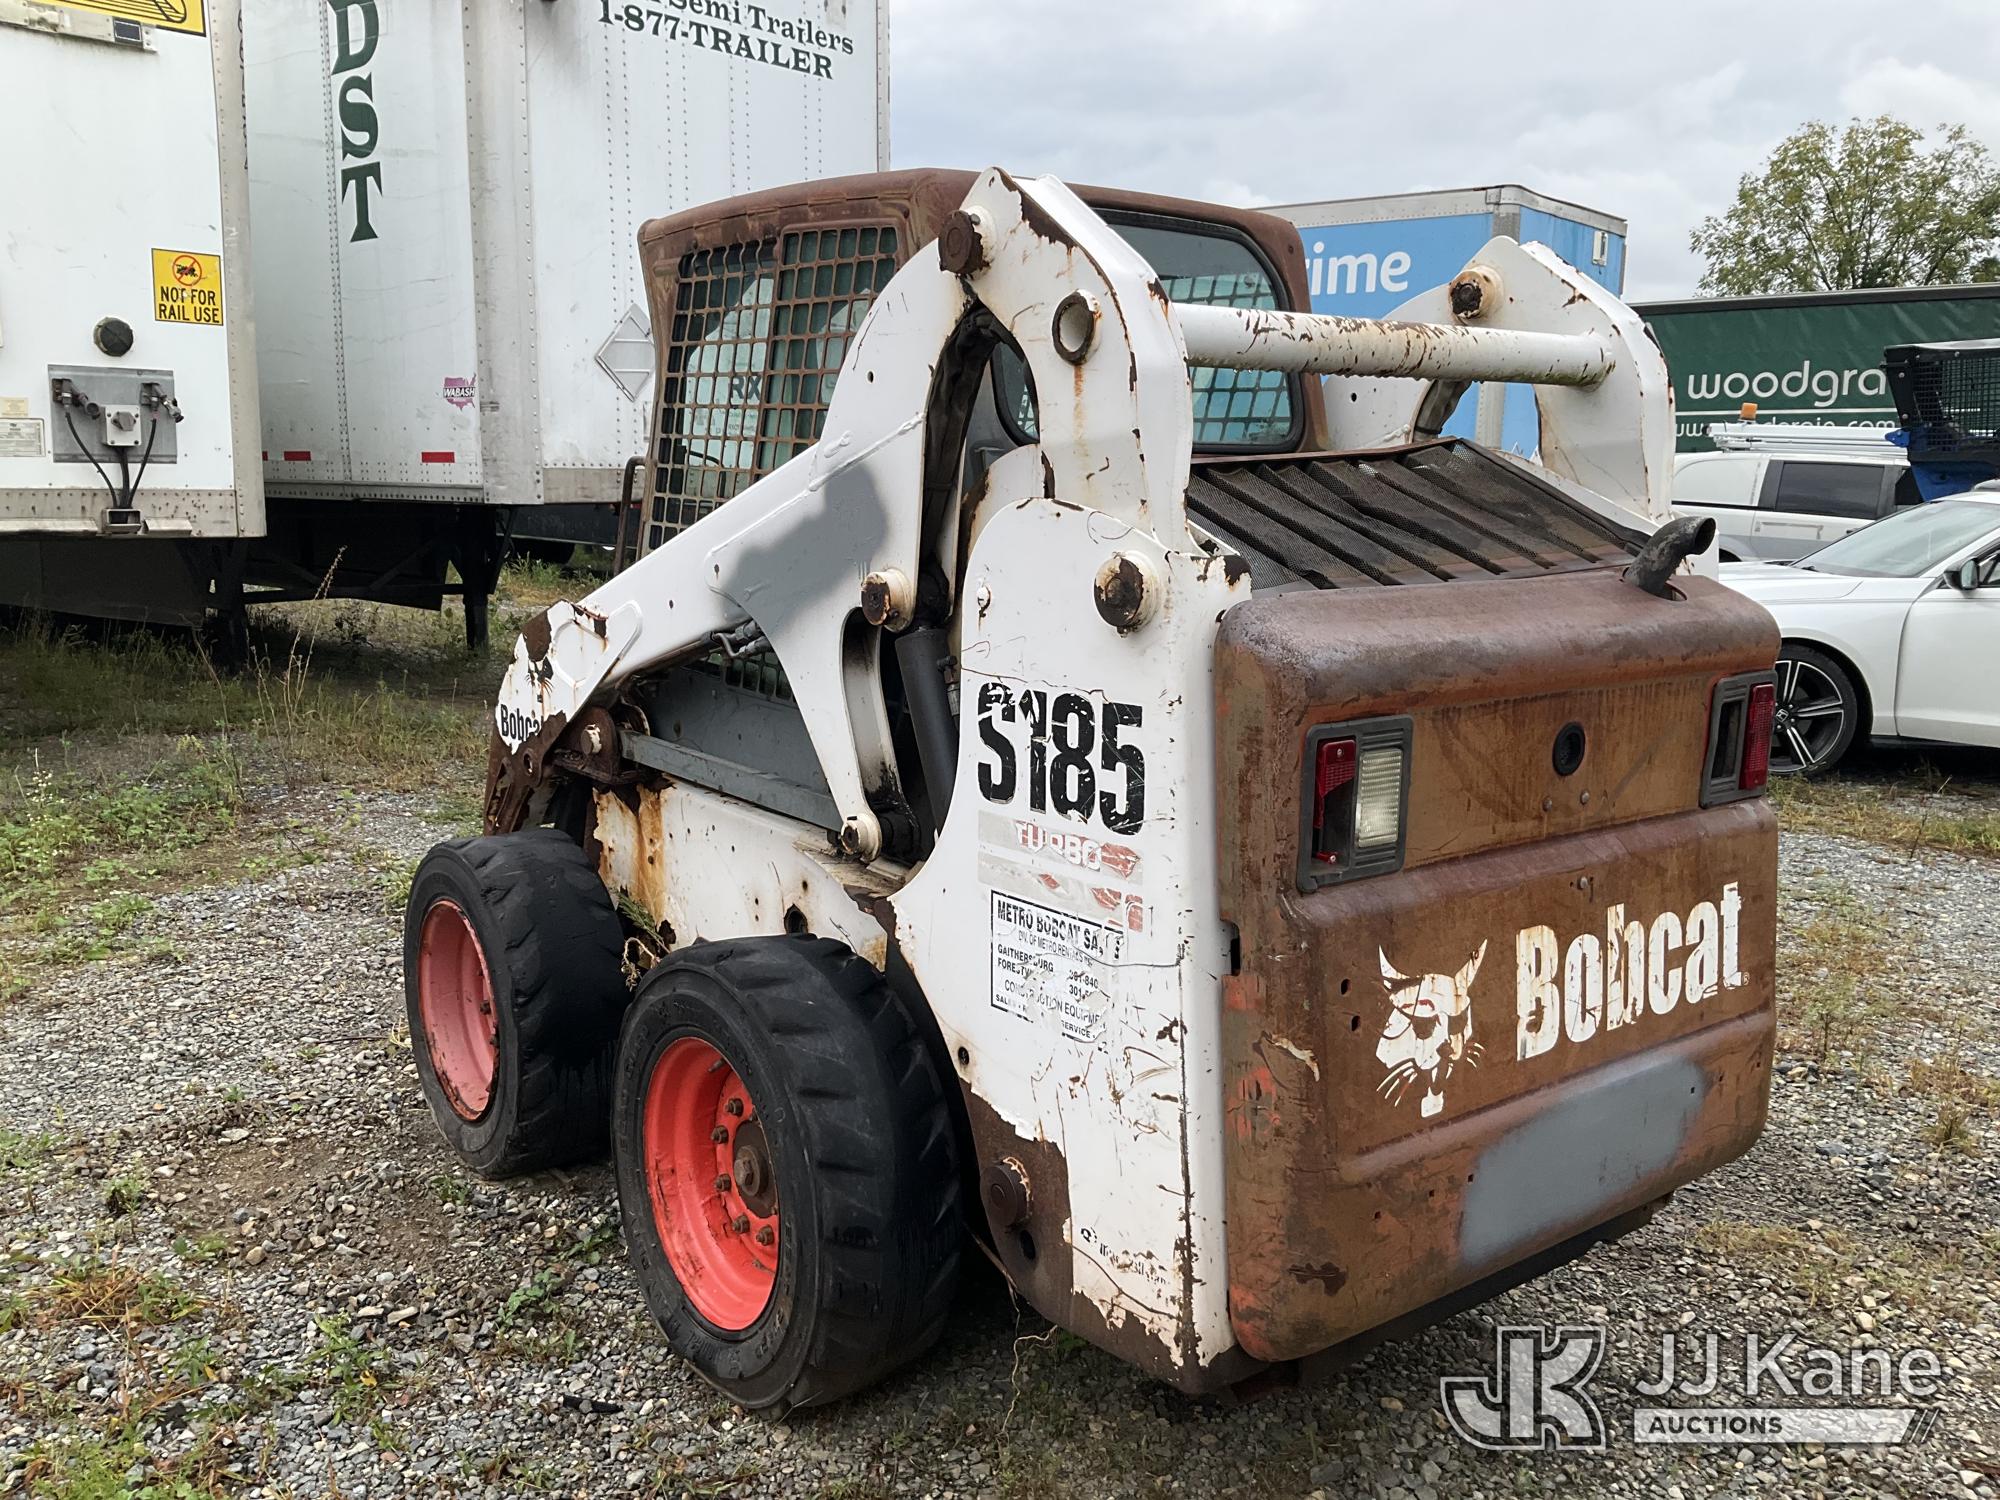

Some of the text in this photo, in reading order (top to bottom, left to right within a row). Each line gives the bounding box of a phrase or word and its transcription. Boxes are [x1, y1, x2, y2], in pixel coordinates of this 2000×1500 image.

[598, 0, 833, 79] 1-877-TRAILER
[748, 5, 853, 54] Trailers
[1305, 241, 1411, 296] ime
[159, 304, 220, 323] RAIL USE
[161, 286, 216, 306] NOT FOR
[444, 387, 475, 397] WABASH
[501, 704, 544, 741] Bobca
[978, 682, 1145, 835] S185
[997, 899, 1034, 930] METRO
[1036, 914, 1081, 948] BOBCAT
[1516, 881, 1742, 1061] Bobcat
